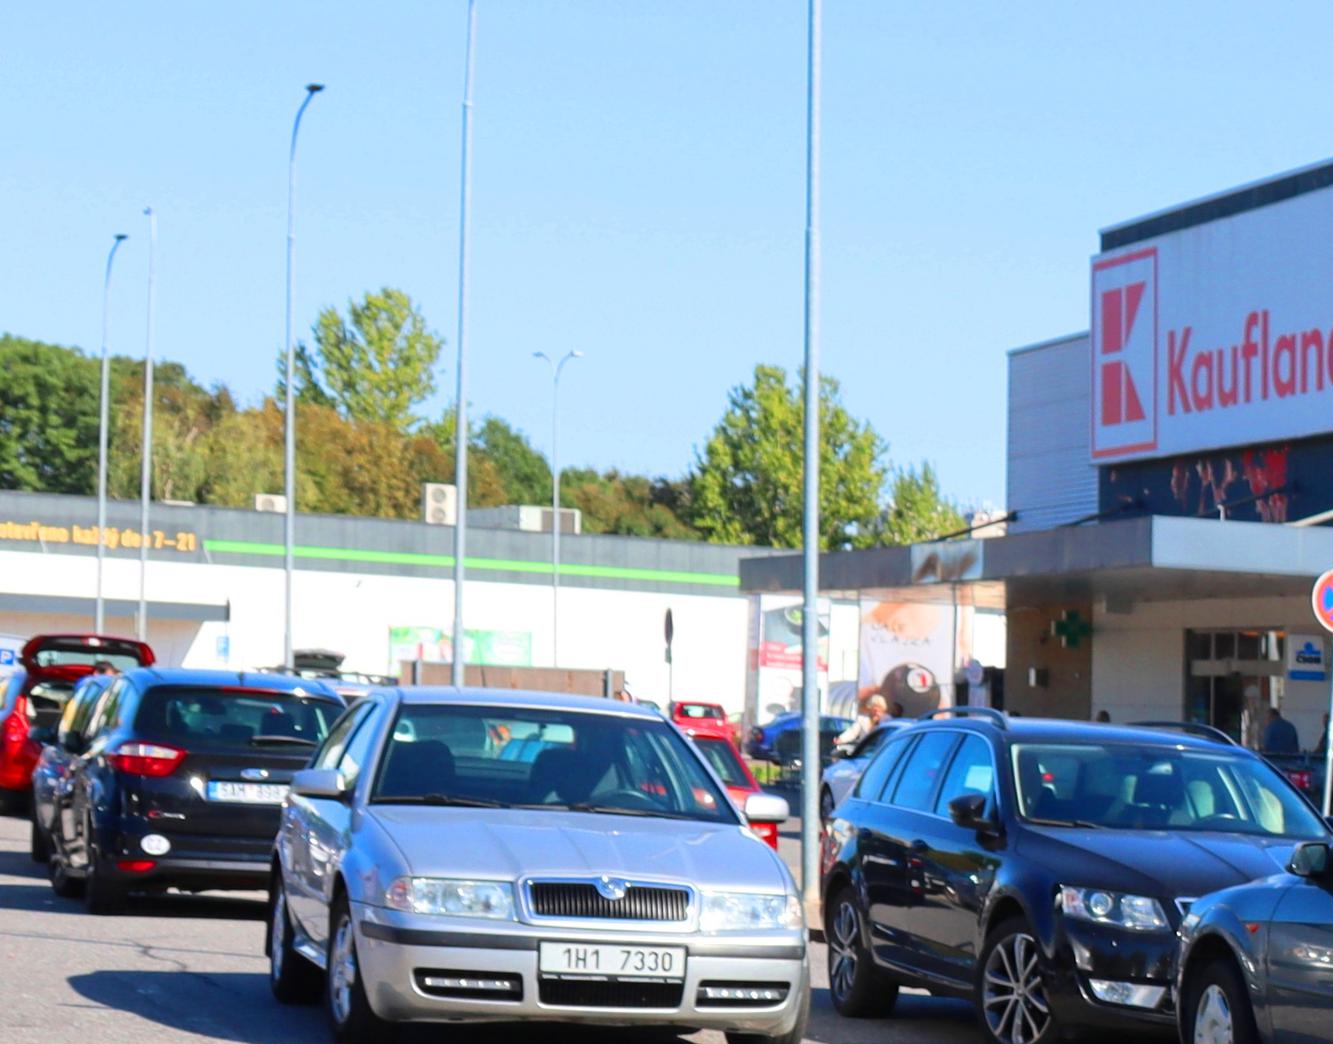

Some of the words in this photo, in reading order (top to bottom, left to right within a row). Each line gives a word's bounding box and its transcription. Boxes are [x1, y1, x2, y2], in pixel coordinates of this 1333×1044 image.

[73, 524, 119, 549] kažý
[563, 947, 600, 970] 1H1
[620, 950, 673, 972] 7330
